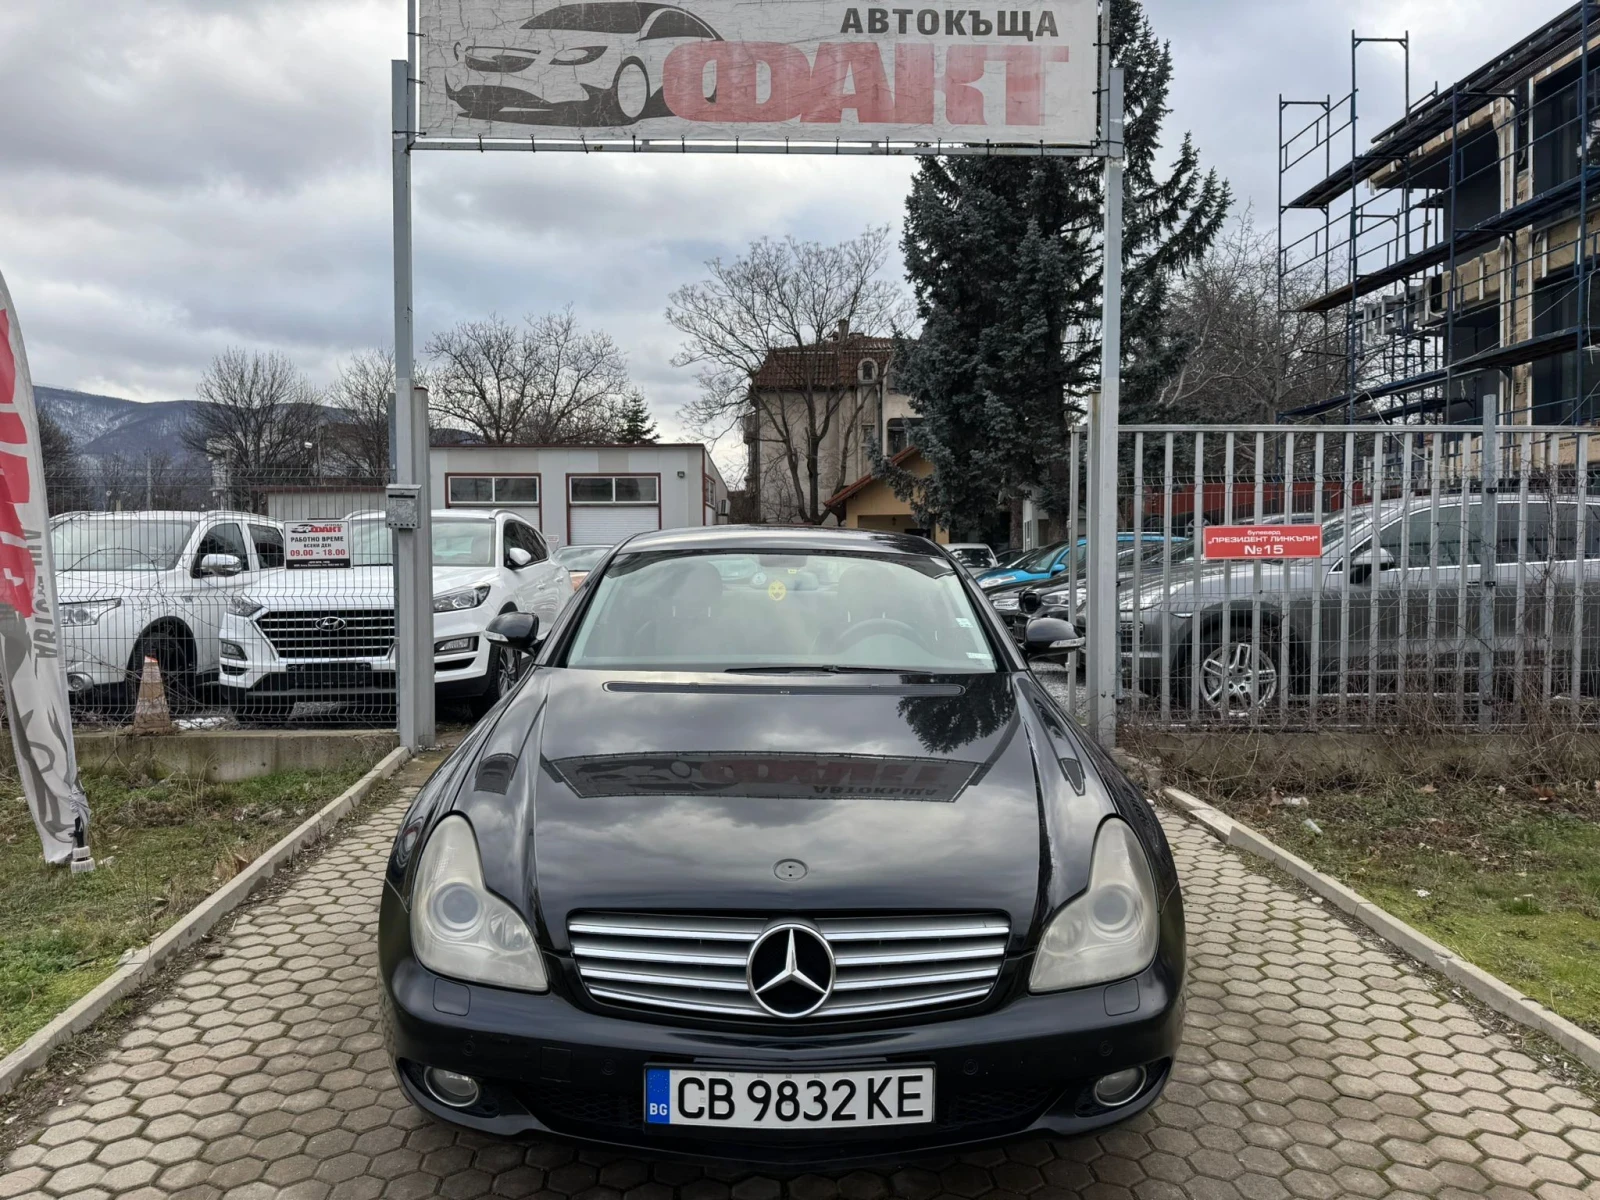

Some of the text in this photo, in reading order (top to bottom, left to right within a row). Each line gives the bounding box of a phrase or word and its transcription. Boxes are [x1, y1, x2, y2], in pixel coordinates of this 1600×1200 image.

[840, 7, 1059, 42] АВТОКЪЩА
[662, 41, 1070, 126] ФАКТ
[290, 549, 313, 557] 09.00
[649, 1103, 668, 1116] BG
[678, 1074, 924, 1122] CB 9832 KE
